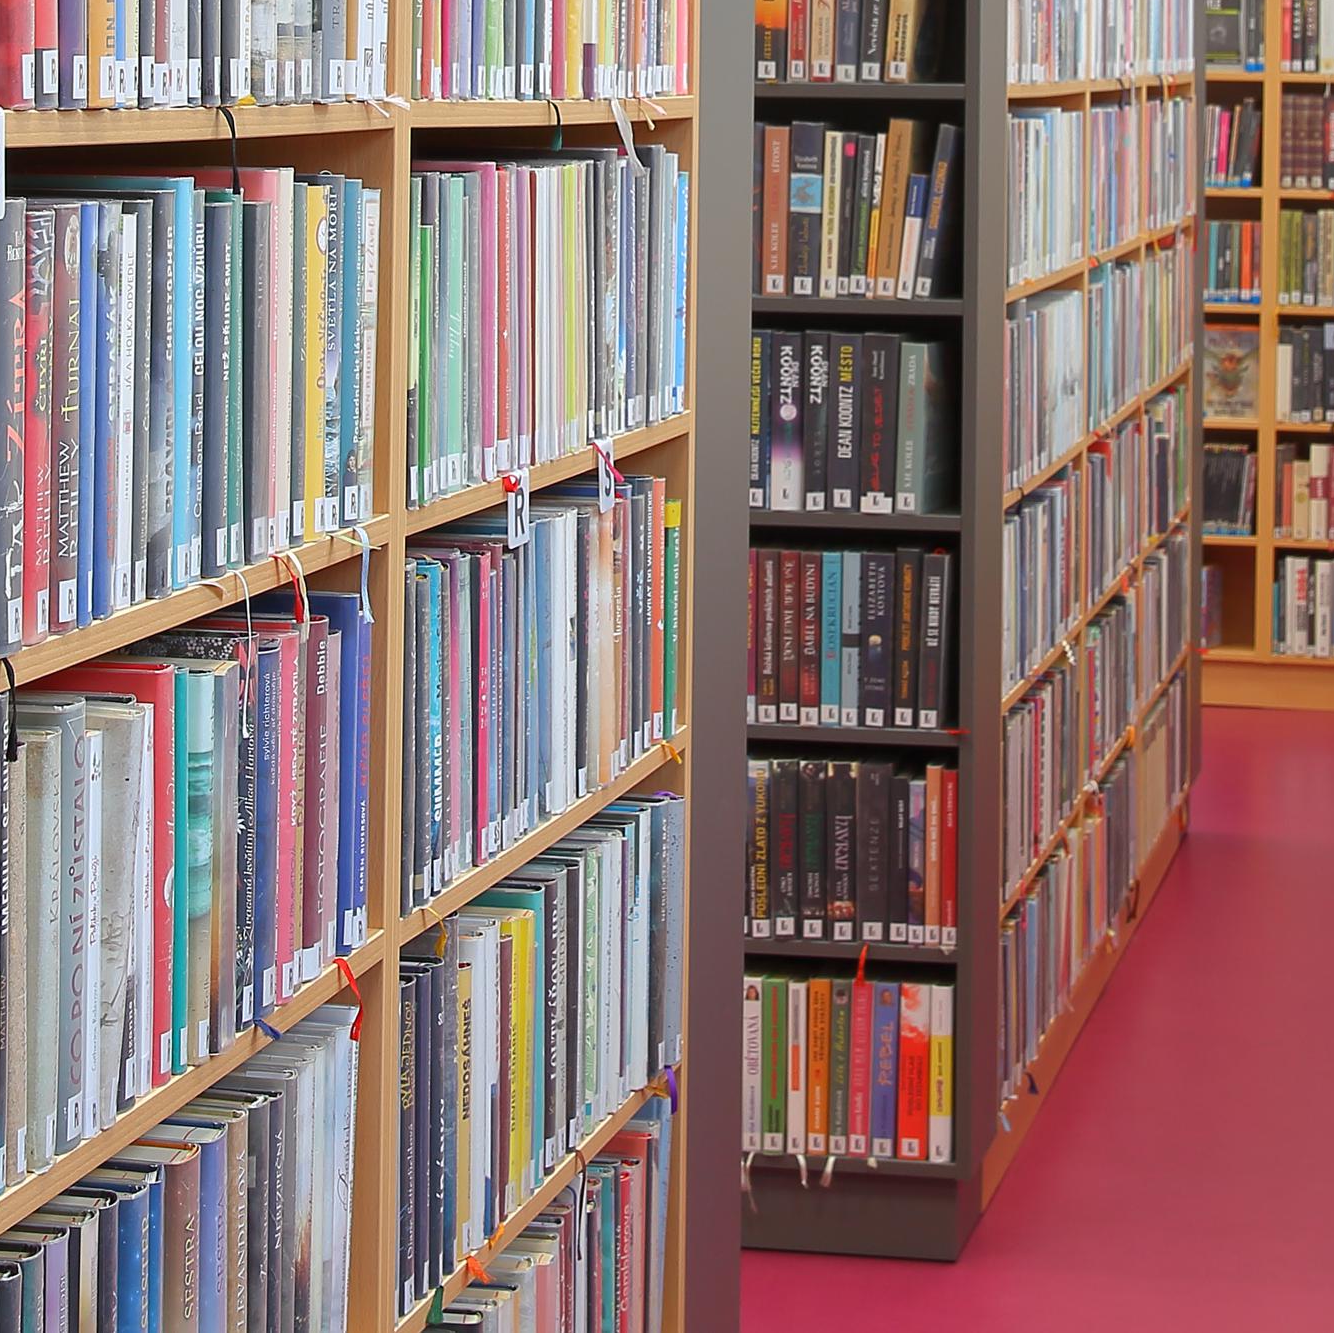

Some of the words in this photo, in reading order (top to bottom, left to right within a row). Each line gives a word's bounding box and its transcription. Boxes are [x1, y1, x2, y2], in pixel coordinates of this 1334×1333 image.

[780, 346, 793, 404] KOONTZ
[809, 346, 822, 404] KOONTZ
[837, 346, 854, 382] MĚSTO
[838, 386, 854, 428] KOONTZ
[837, 430, 854, 459] DEAN
[58, 441, 70, 558] MATTHEW
[514, 489, 526, 529] R
[753, 827, 767, 861] ZLATO
